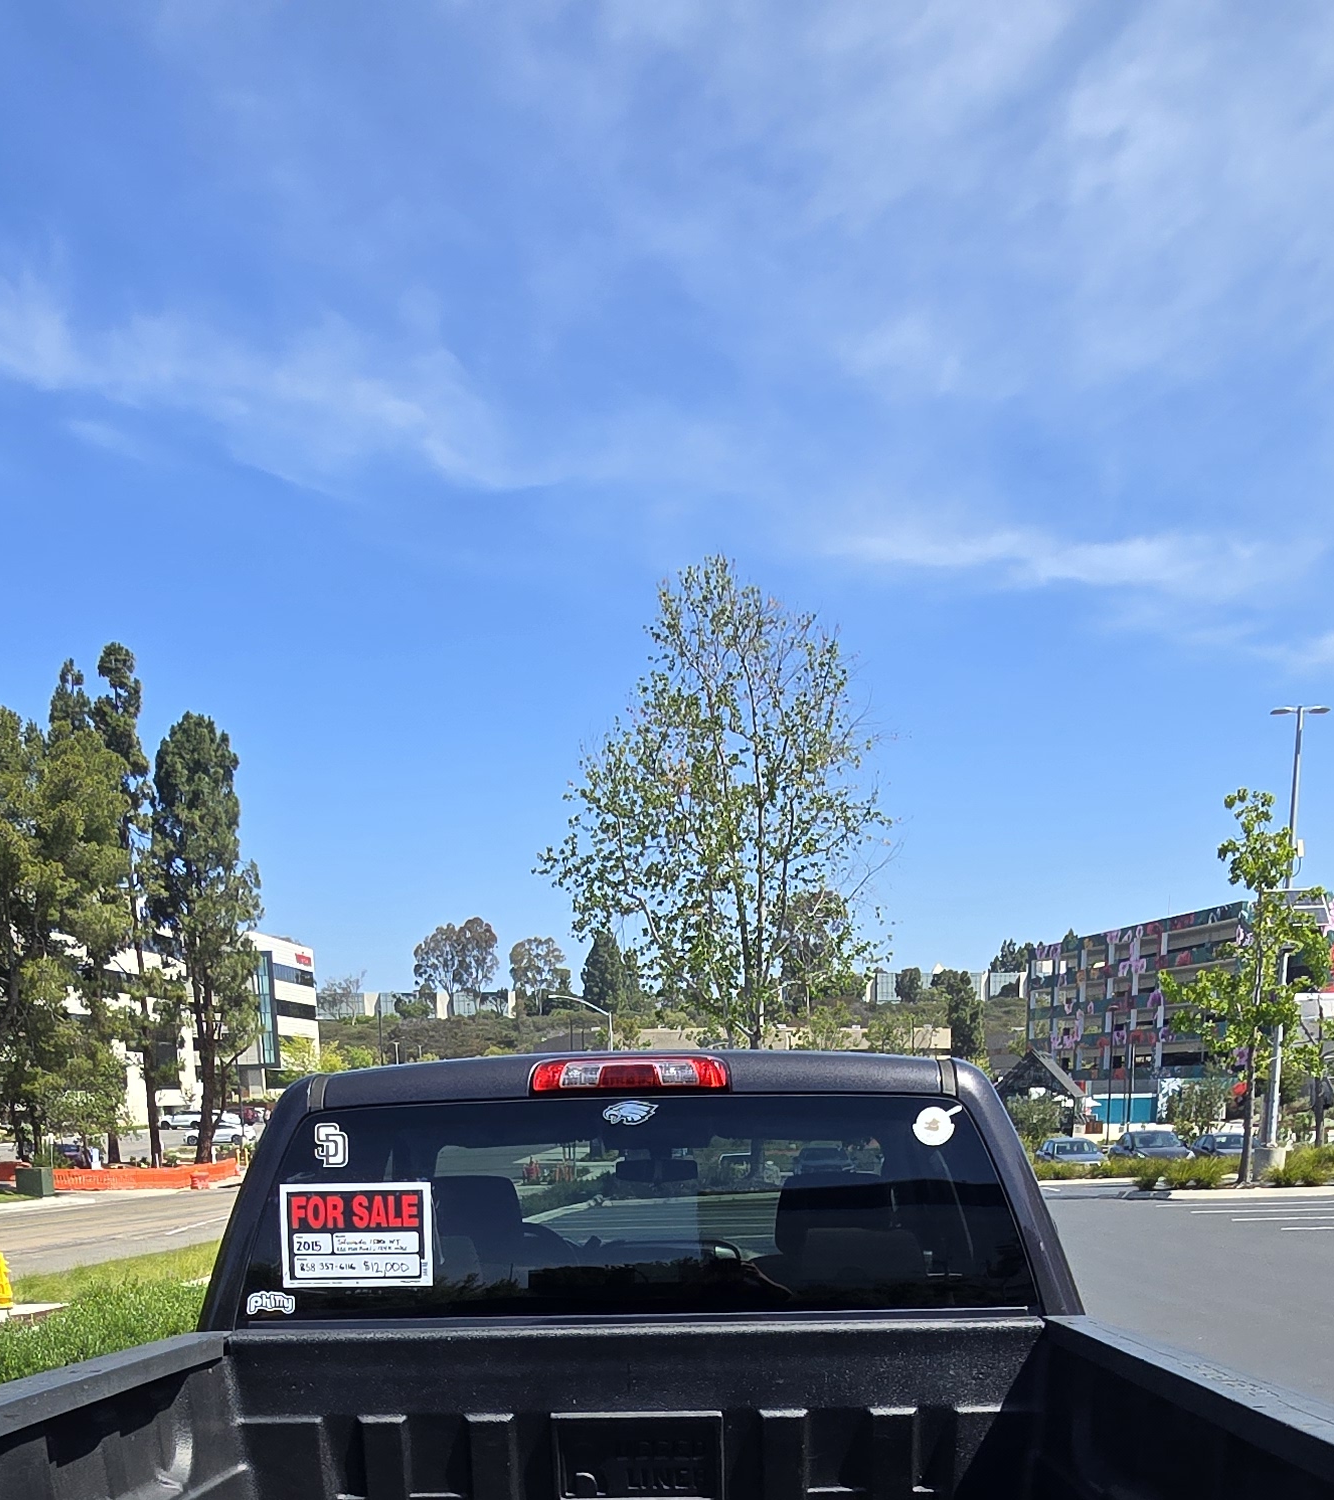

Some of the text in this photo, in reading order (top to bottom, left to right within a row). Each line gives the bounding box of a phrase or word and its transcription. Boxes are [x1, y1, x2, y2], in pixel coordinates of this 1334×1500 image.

[291, 1194, 419, 1229] FOR SALE
[296, 1240, 322, 1252] 2015
[300, 1262, 316, 1272] 858
[363, 1260, 410, 1277] $12,000
